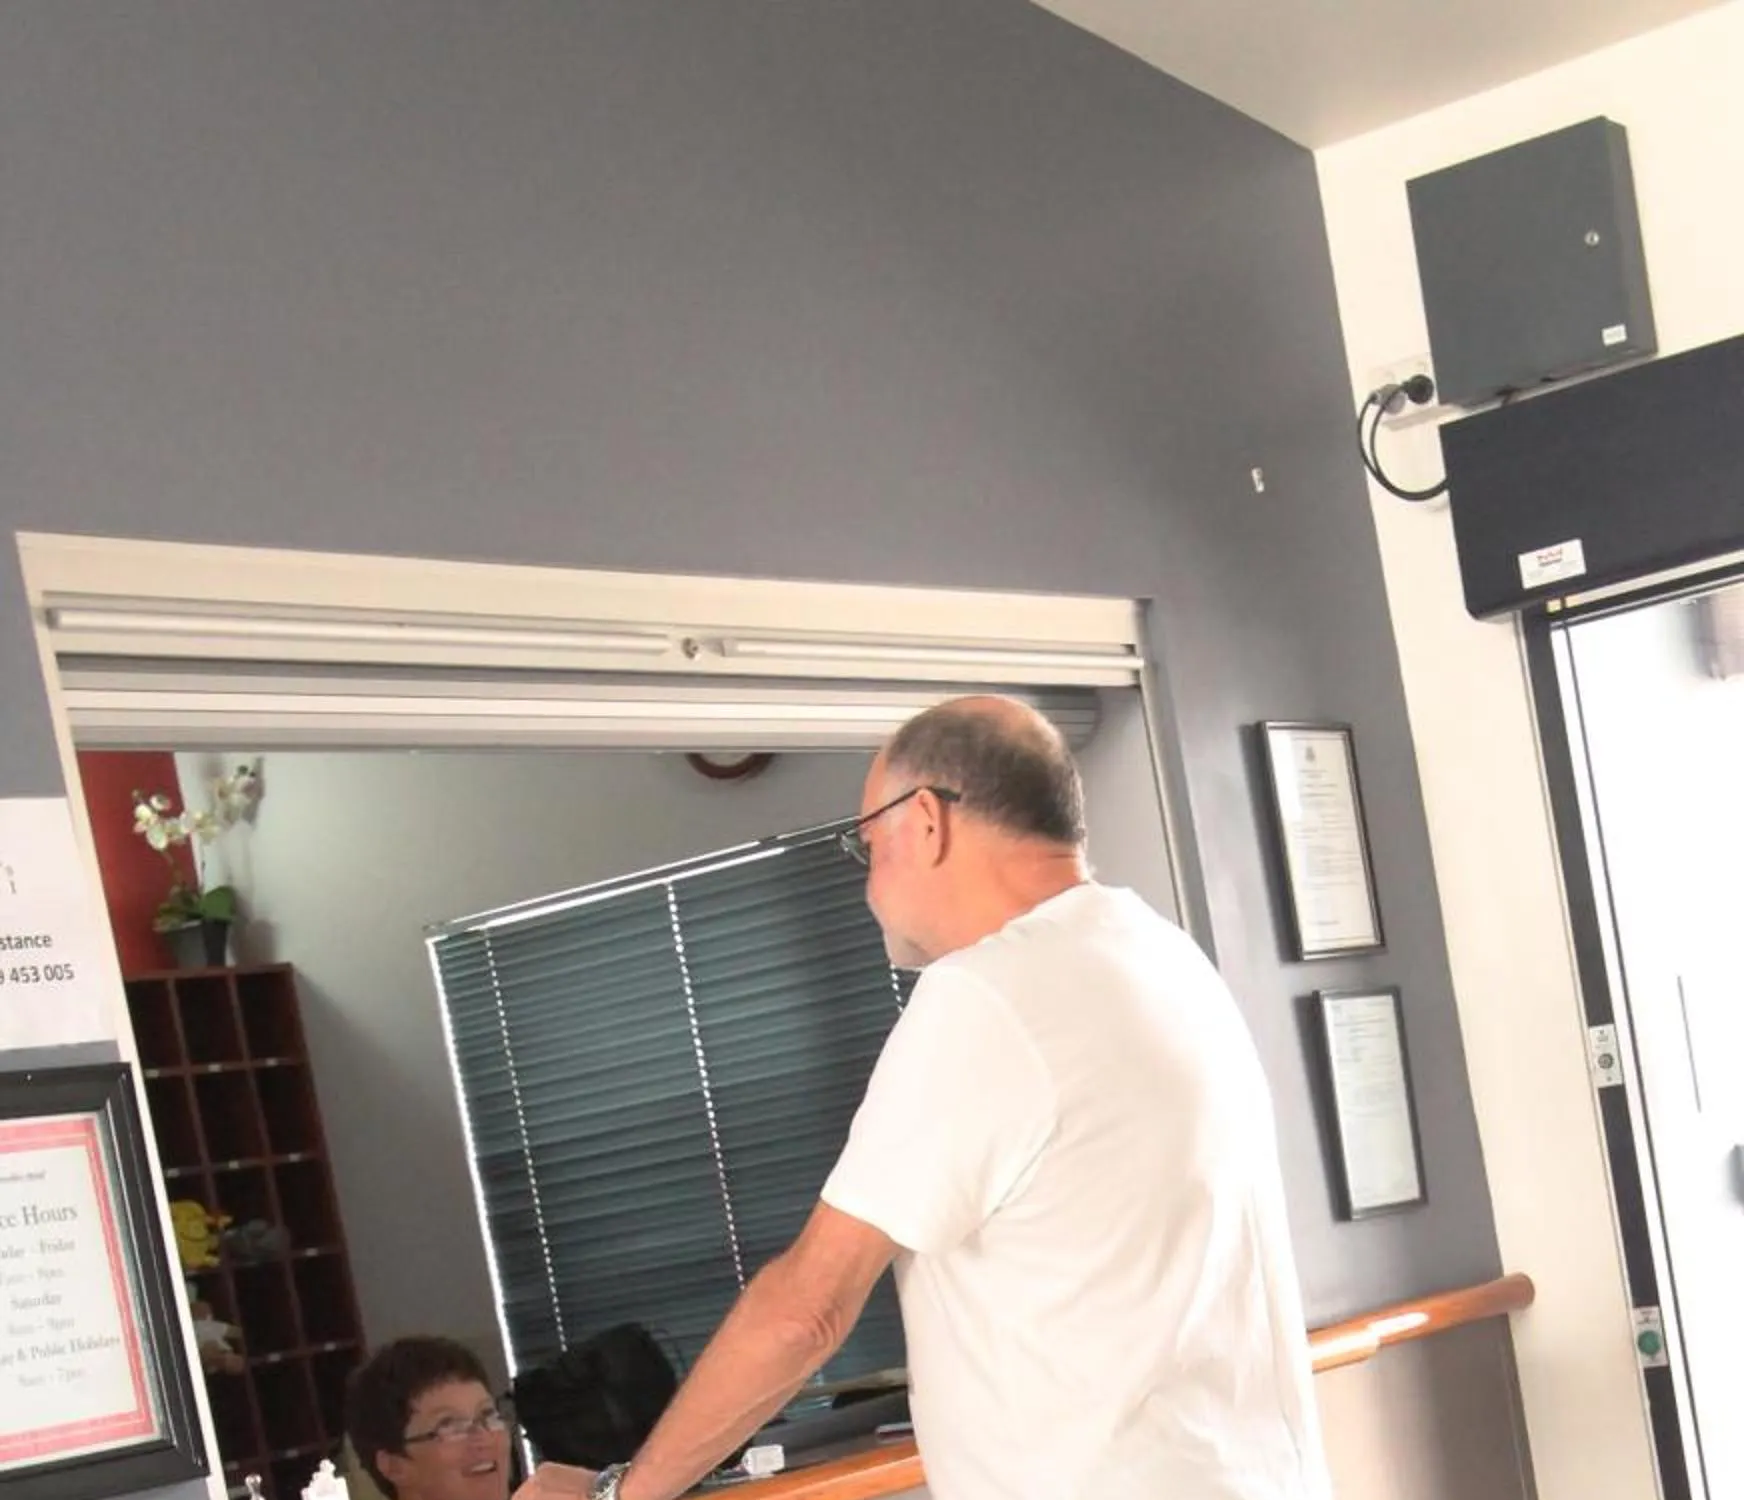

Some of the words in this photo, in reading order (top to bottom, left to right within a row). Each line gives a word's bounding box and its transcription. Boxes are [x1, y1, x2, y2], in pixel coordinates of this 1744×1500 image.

[10, 965, 40, 984] 453
[43, 963, 75, 981] 005
[22, 1203, 78, 1226] Hours
[10, 1293, 62, 1310] Saturday
[30, 1342, 66, 1360] Public
